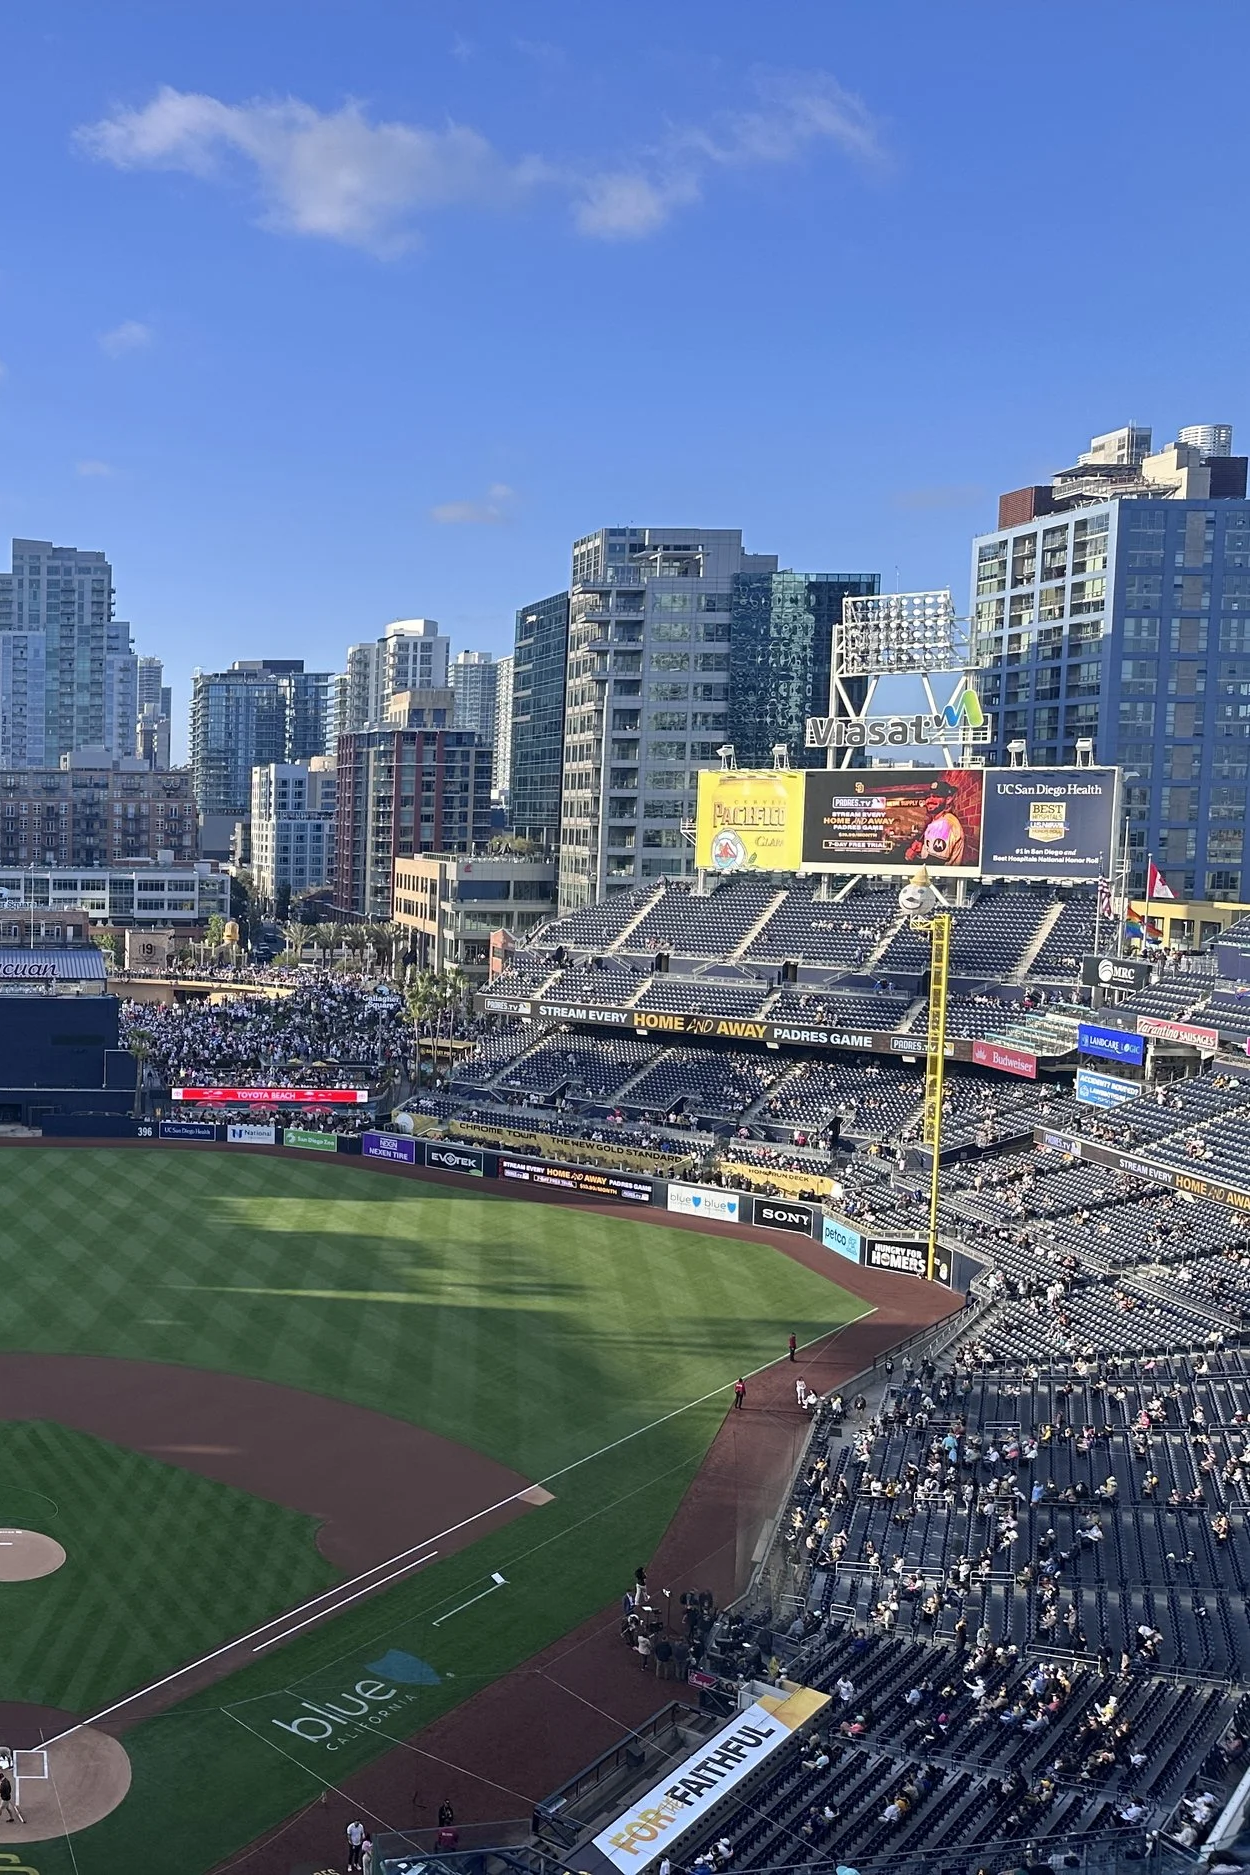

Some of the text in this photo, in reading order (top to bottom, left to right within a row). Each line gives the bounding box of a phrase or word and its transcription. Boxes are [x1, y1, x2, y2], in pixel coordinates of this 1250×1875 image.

[808, 717, 931, 746] Viasat
[997, 784, 1102, 797] UC San Diego Health
[1033, 804, 1063, 814] BEST
[823, 817, 851, 825] HOME
[143, 944, 153, 955] 19
[1113, 966, 1135, 979] MRC
[539, 1005, 873, 1048] STREAM EVERY HOME AND AWAY PADRES GAME
[1138, 1020, 1215, 1047] Tarantino SAUSAGES
[1089, 1036, 1120, 1049] LANDCARE
[993, 1051, 1033, 1073] Budweiser
[237, 1091, 296, 1100] TOYOTA BEACH
[137, 1126, 152, 1137] 396
[459, 1122, 682, 1163] CHROME TOUR THE NEW GOLD STANDARD
[370, 1147, 408, 1160] NEXEN TIRE
[503, 1161, 526, 1171] STREAM
[546, 1168, 570, 1179] HOME
[584, 1175, 607, 1185] AWAY
[789, 1174, 810, 1182] DECK
[1119, 1158, 1148, 1175] STREAM
[1149, 1167, 1173, 1183] EVERY
[1175, 1176, 1207, 1196] HOME
[670, 1193, 691, 1203] blue
[704, 1198, 727, 1210] blue
[762, 1208, 809, 1225] SONY
[825, 1226, 846, 1246] petco
[875, 1243, 922, 1259] HUNGRY FOR
[272, 1679, 397, 1745] blue
[326, 1692, 418, 1751] CALIFORNIA
[608, 1725, 776, 1856] FOR FAITHFUL
